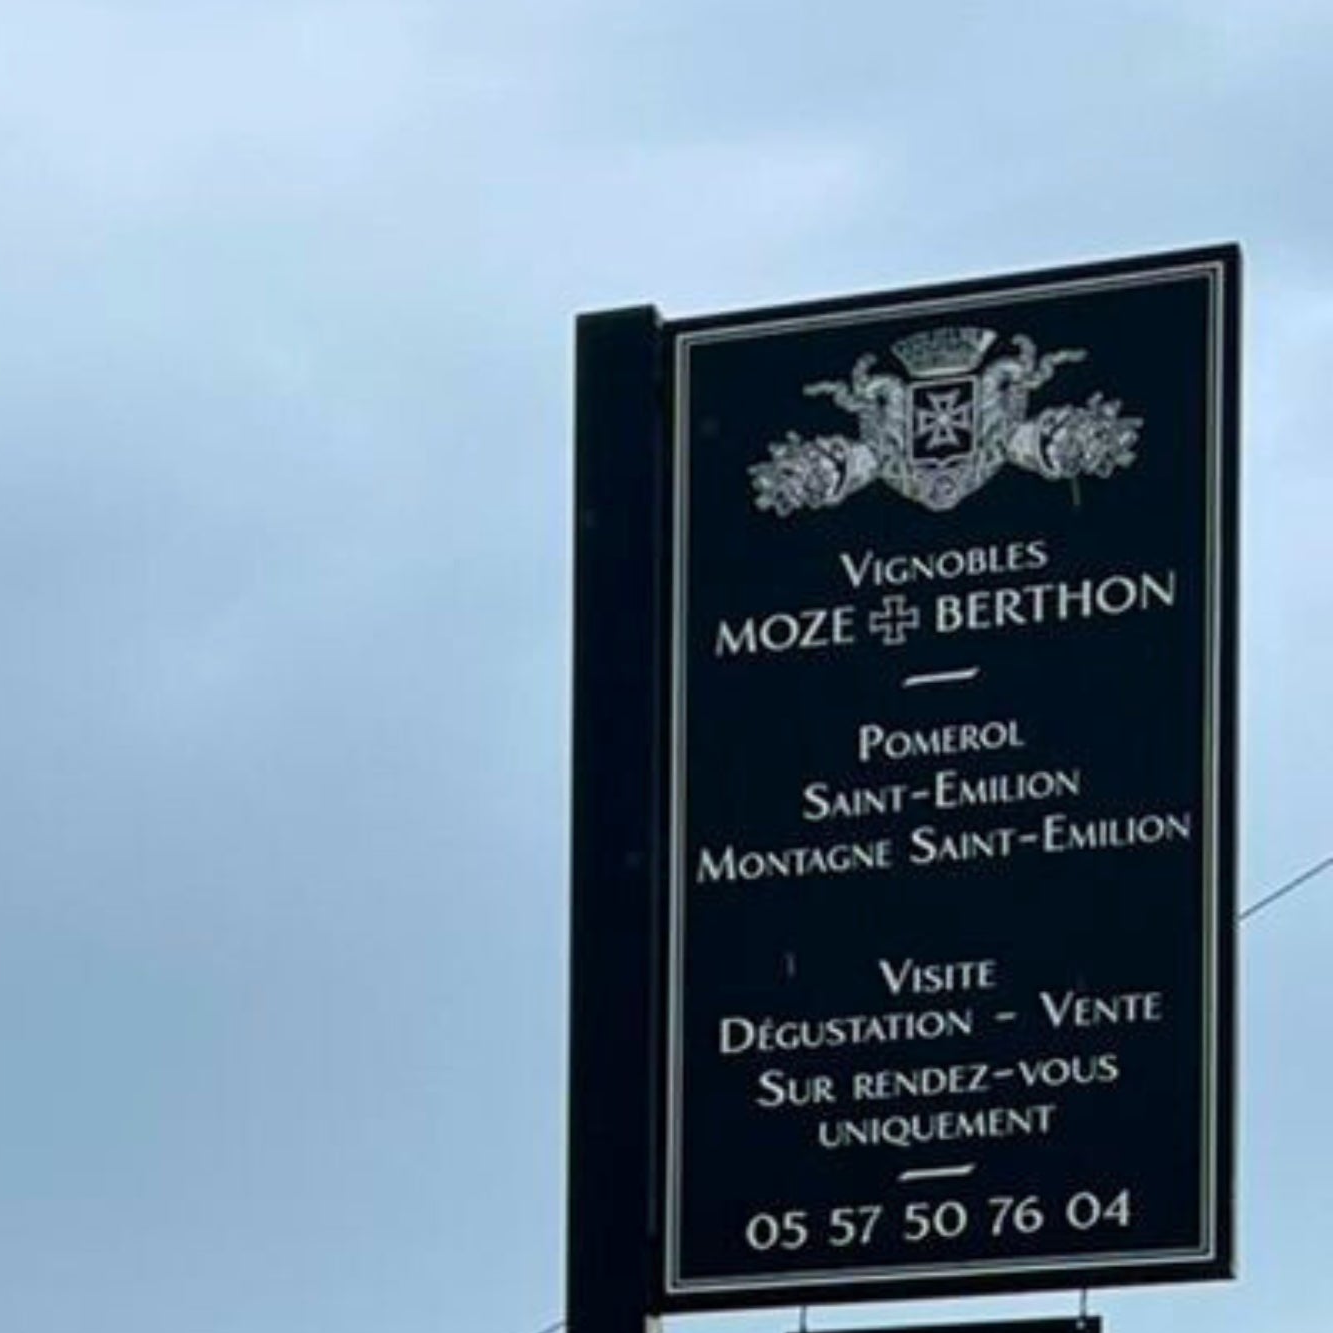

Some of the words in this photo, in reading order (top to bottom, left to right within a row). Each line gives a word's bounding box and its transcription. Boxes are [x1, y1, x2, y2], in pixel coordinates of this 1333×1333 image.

[715, 606, 855, 656] MOZE
[936, 571, 1175, 632] BERTHON
[819, 1105, 1055, 1147] UNIQUEMENT
[746, 1211, 808, 1251] 05
[830, 1206, 882, 1245] 57
[905, 1201, 967, 1240] 50
[990, 1195, 1044, 1235] 76
[1066, 1190, 1130, 1229] 04
